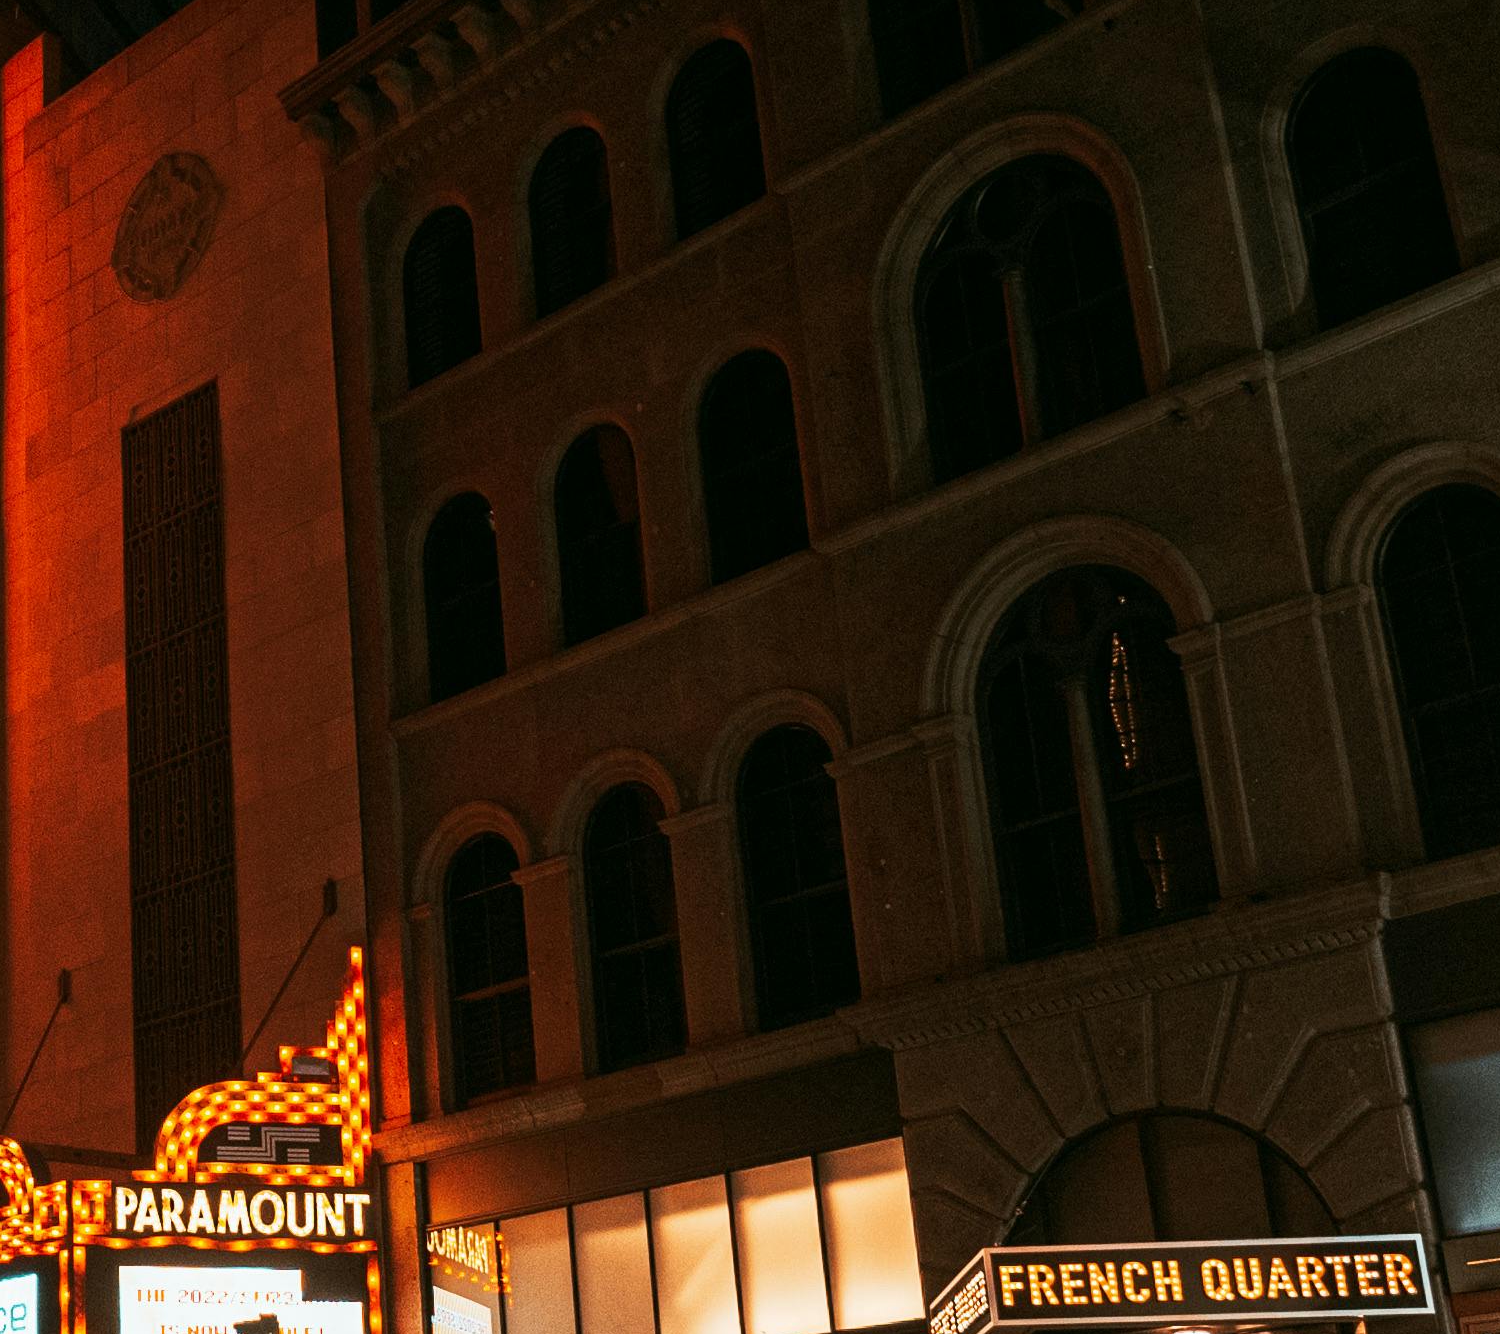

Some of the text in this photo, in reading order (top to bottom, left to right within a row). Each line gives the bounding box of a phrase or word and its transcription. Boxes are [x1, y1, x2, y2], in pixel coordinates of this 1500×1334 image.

[115, 1187, 370, 1237] PARAMOUNT
[1000, 1253, 1419, 1306] FRENCH QUARTER
